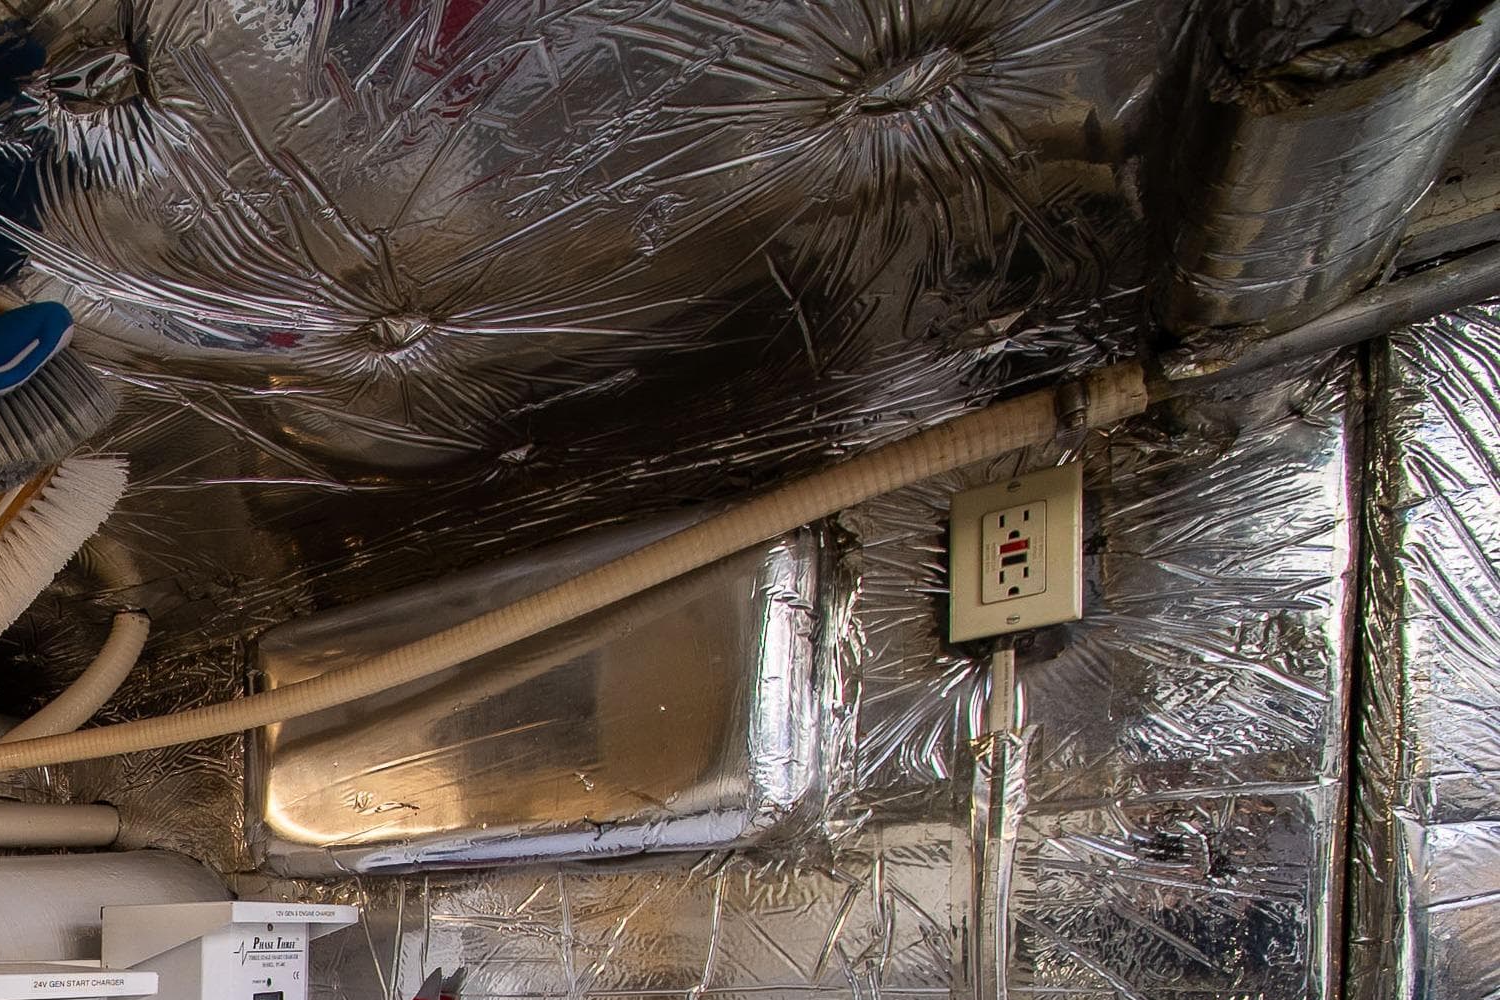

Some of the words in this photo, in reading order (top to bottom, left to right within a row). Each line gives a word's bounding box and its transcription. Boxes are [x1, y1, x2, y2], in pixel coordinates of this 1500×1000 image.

[253, 937, 274, 949] PHASE
[277, 937, 296, 949] THREE
[33, 981, 48, 989] 24V
[49, 980, 66, 988] GEN
[66, 979, 90, 987] START
[91, 978, 125, 987] CHARGER
